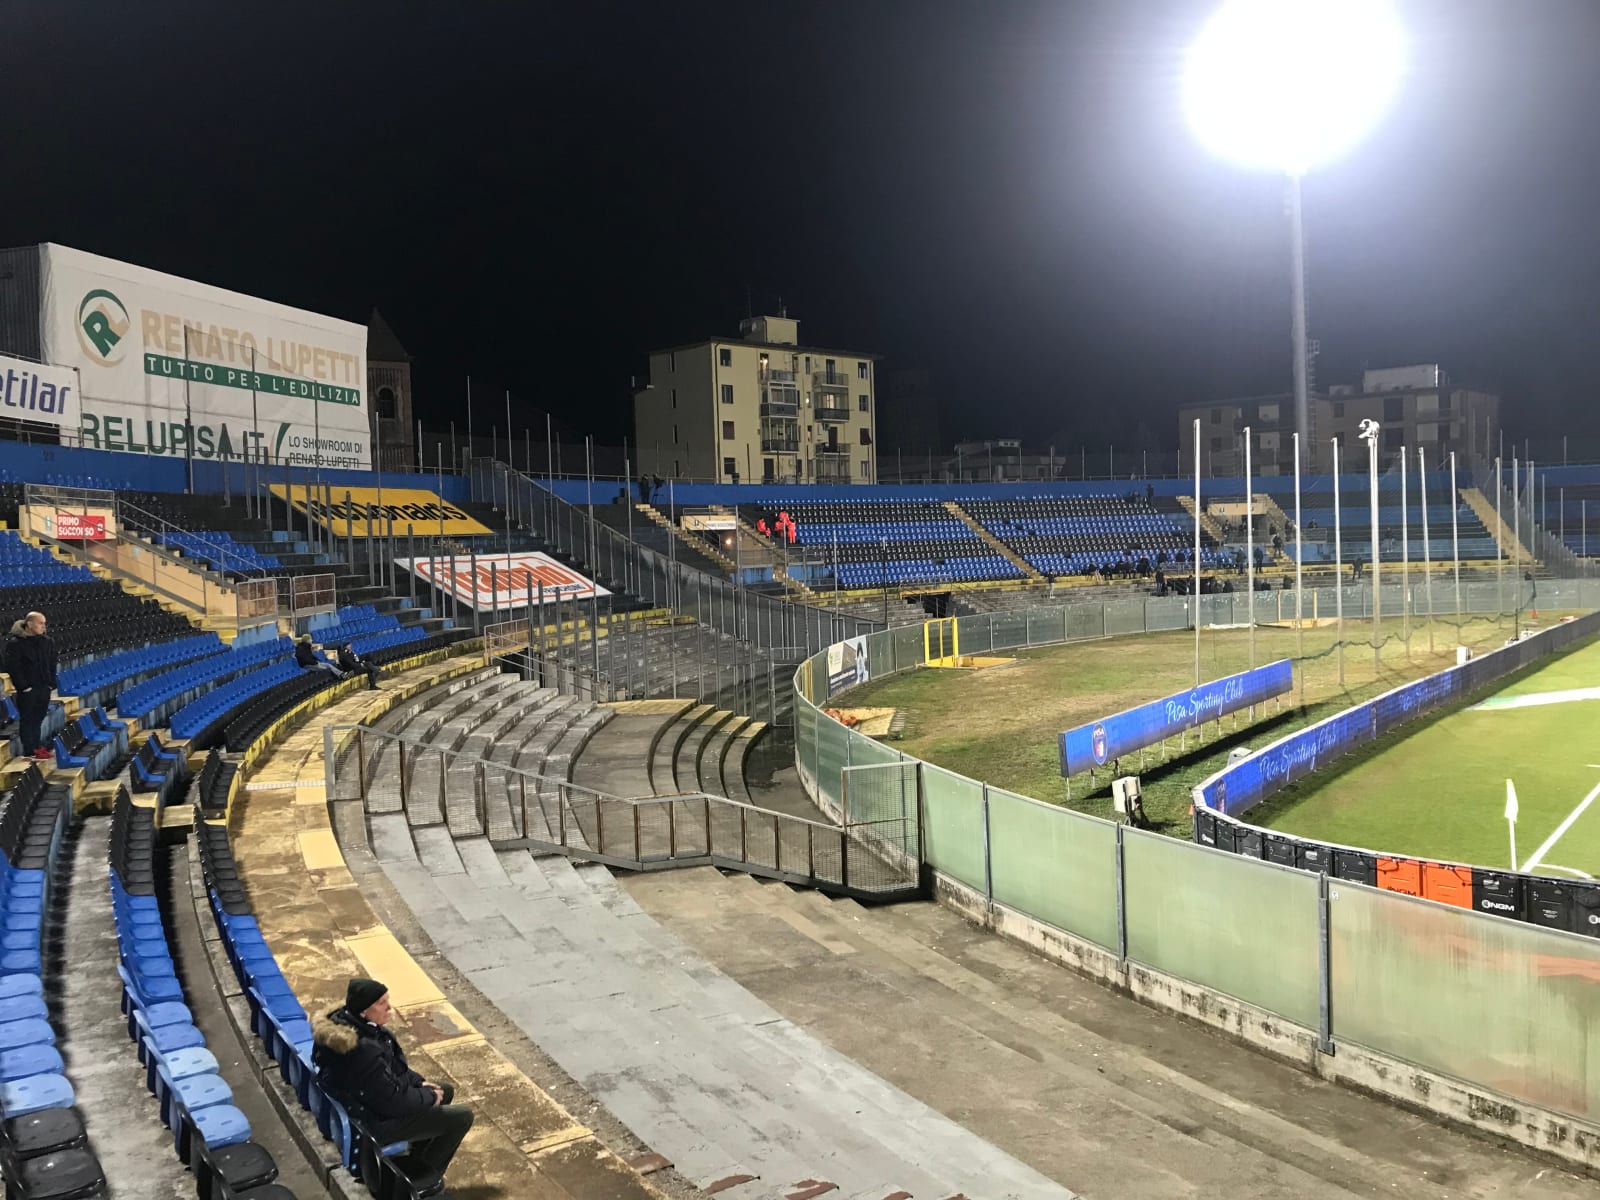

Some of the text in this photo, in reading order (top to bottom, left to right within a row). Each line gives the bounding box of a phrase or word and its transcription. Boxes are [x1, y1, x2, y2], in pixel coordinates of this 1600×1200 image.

[141, 309, 360, 385] RENATO LUPETTI
[147, 356, 359, 404] TUTTO PER L'EDILIZIA
[288, 435, 362, 454] LO SHOWROOM DI
[288, 452, 360, 469] RENATO LUPETTI
[58, 516, 80, 527] PRIMO
[1166, 678, 1244, 725] Pisa Sporting Club
